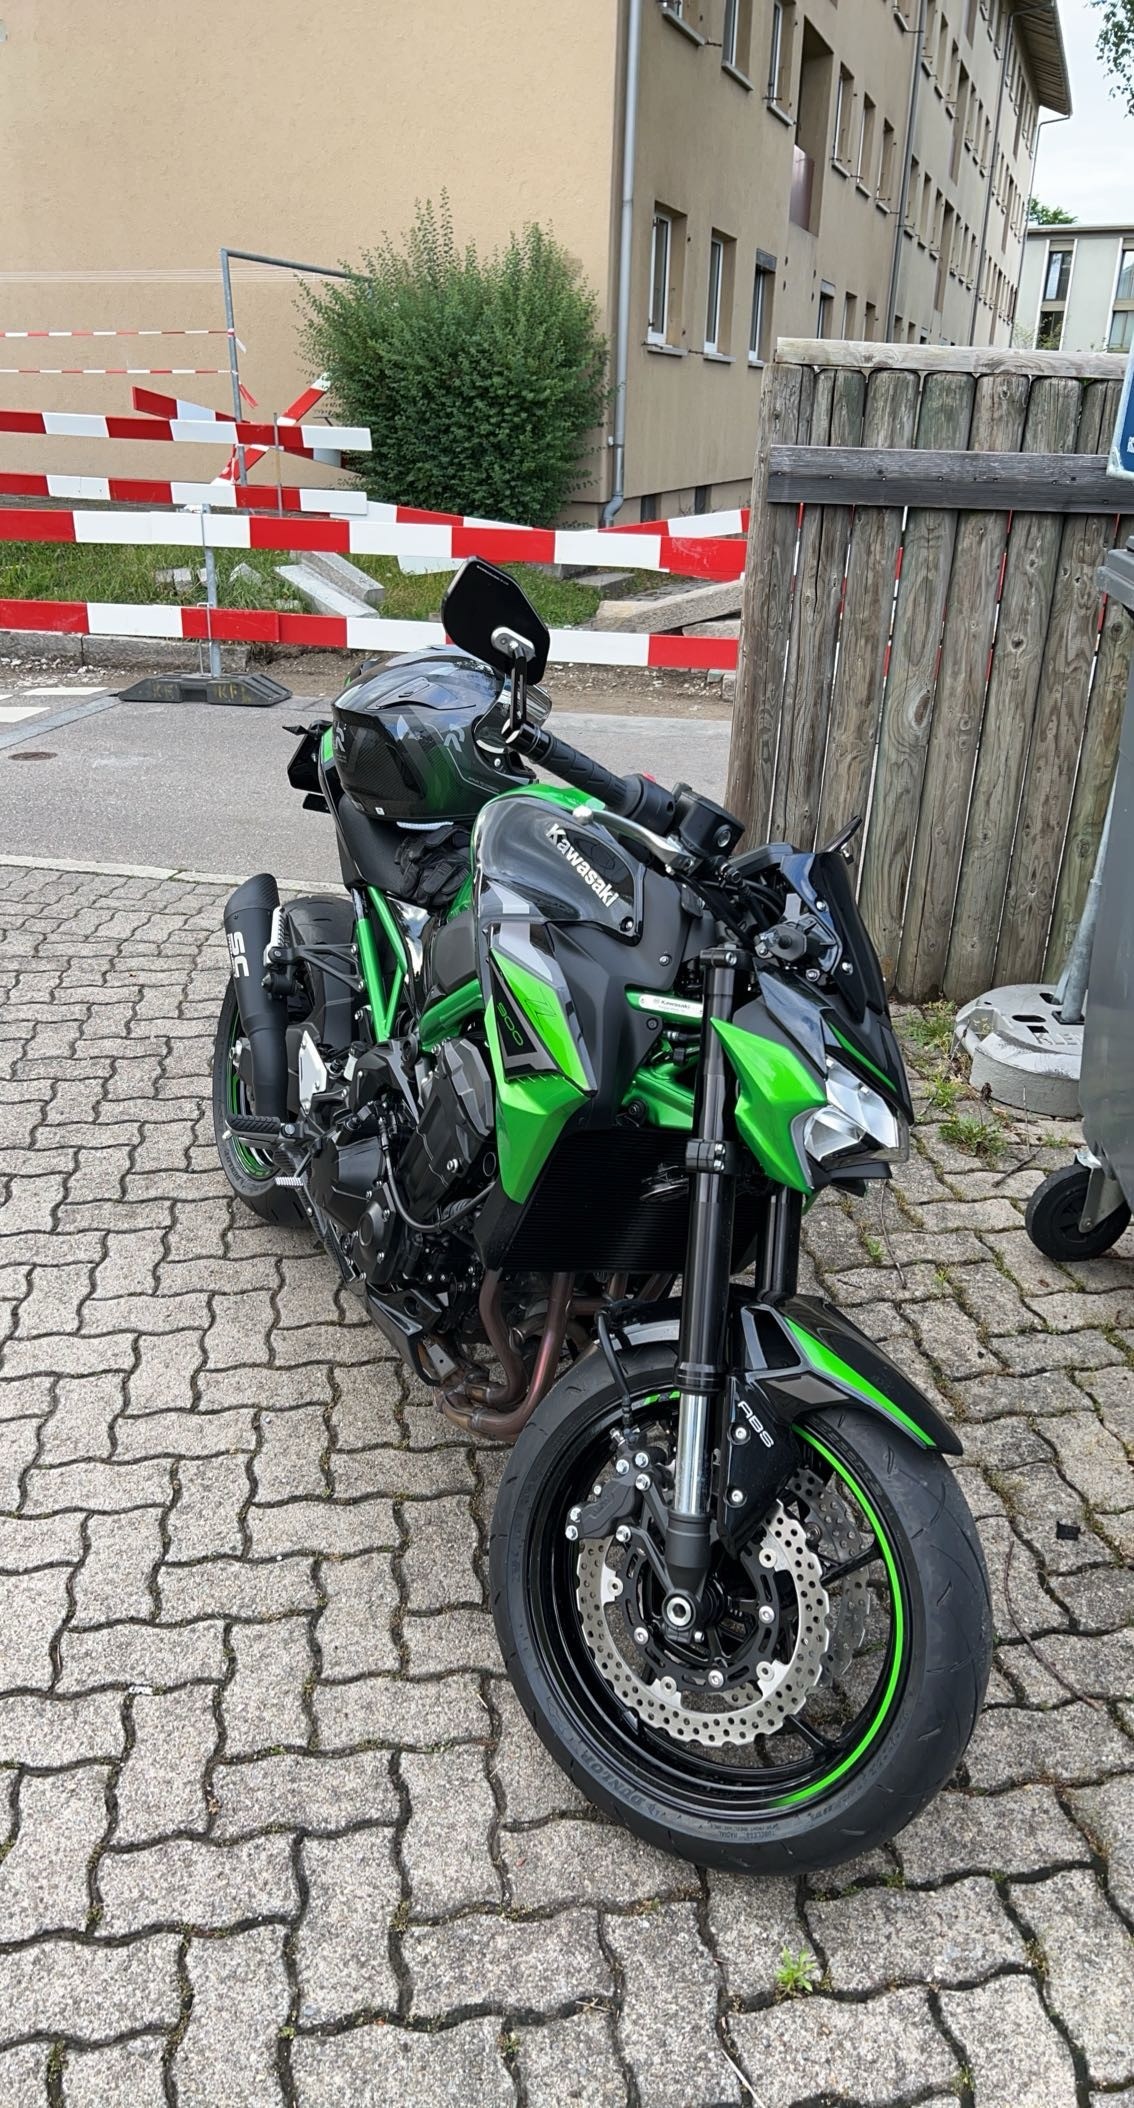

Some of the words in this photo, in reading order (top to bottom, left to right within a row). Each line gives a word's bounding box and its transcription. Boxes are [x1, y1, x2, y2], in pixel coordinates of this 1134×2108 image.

[545, 823, 619, 908] Kawasaki
[230, 931, 249, 978] SC
[497, 1002, 523, 1046] 900
[738, 1401, 774, 1448] ABS
